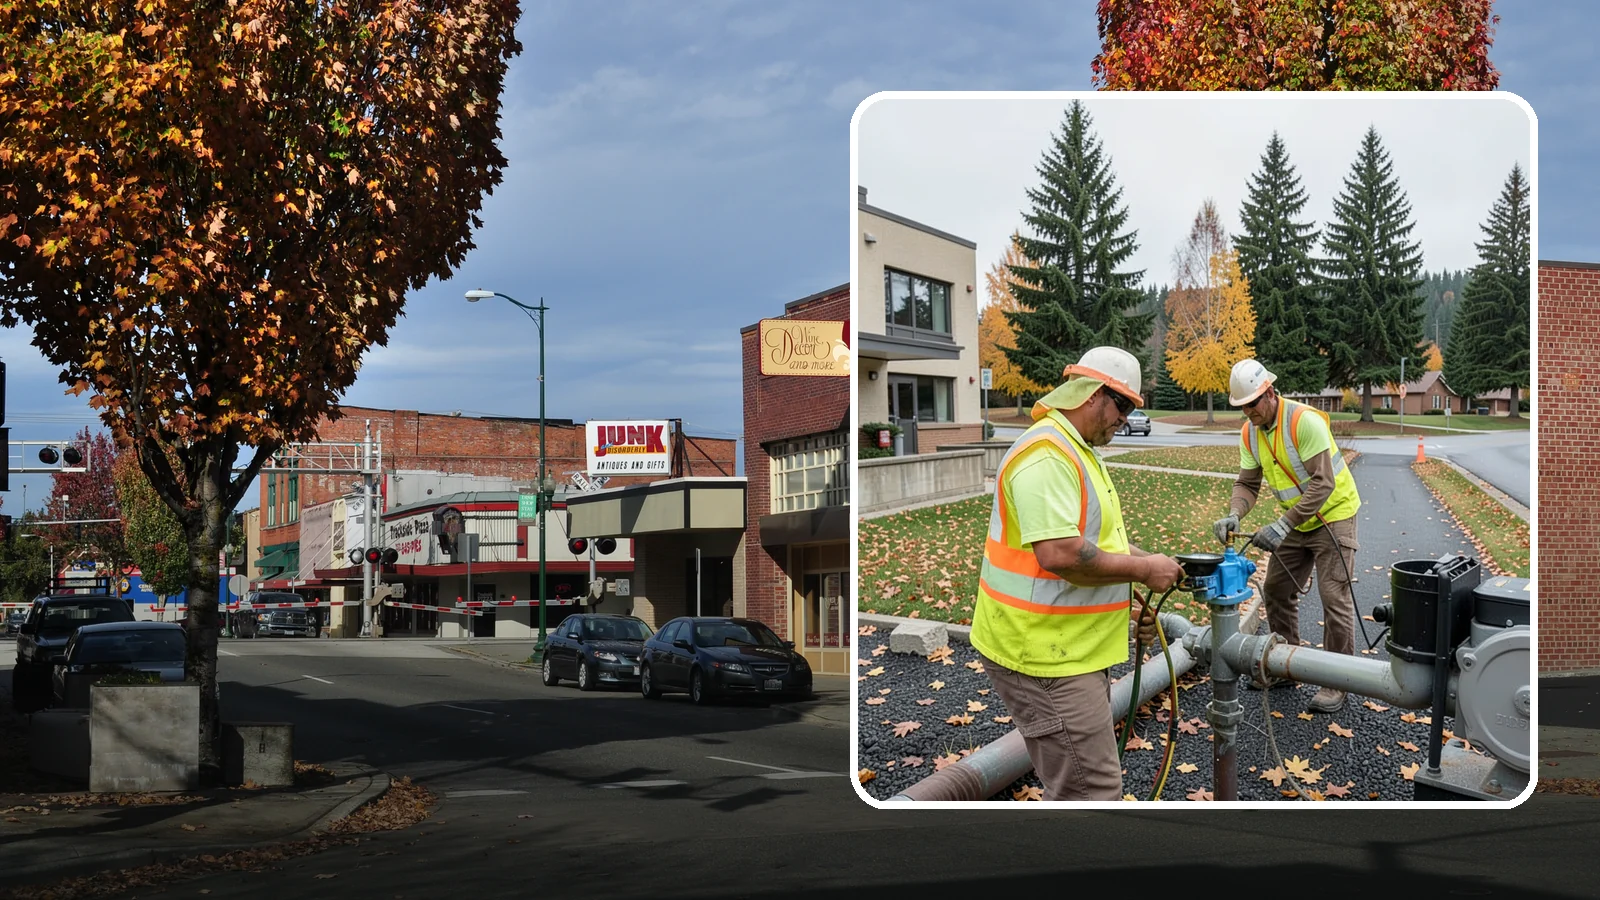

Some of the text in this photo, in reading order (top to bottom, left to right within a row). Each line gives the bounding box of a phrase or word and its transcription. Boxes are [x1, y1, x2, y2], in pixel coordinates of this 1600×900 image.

[595, 425, 665, 457] JUNK
[607, 446, 646, 454] DISORDERLY
[596, 460, 665, 470] ANTIQUES AND GIFTS
[414, 519, 429, 535] Pizza
